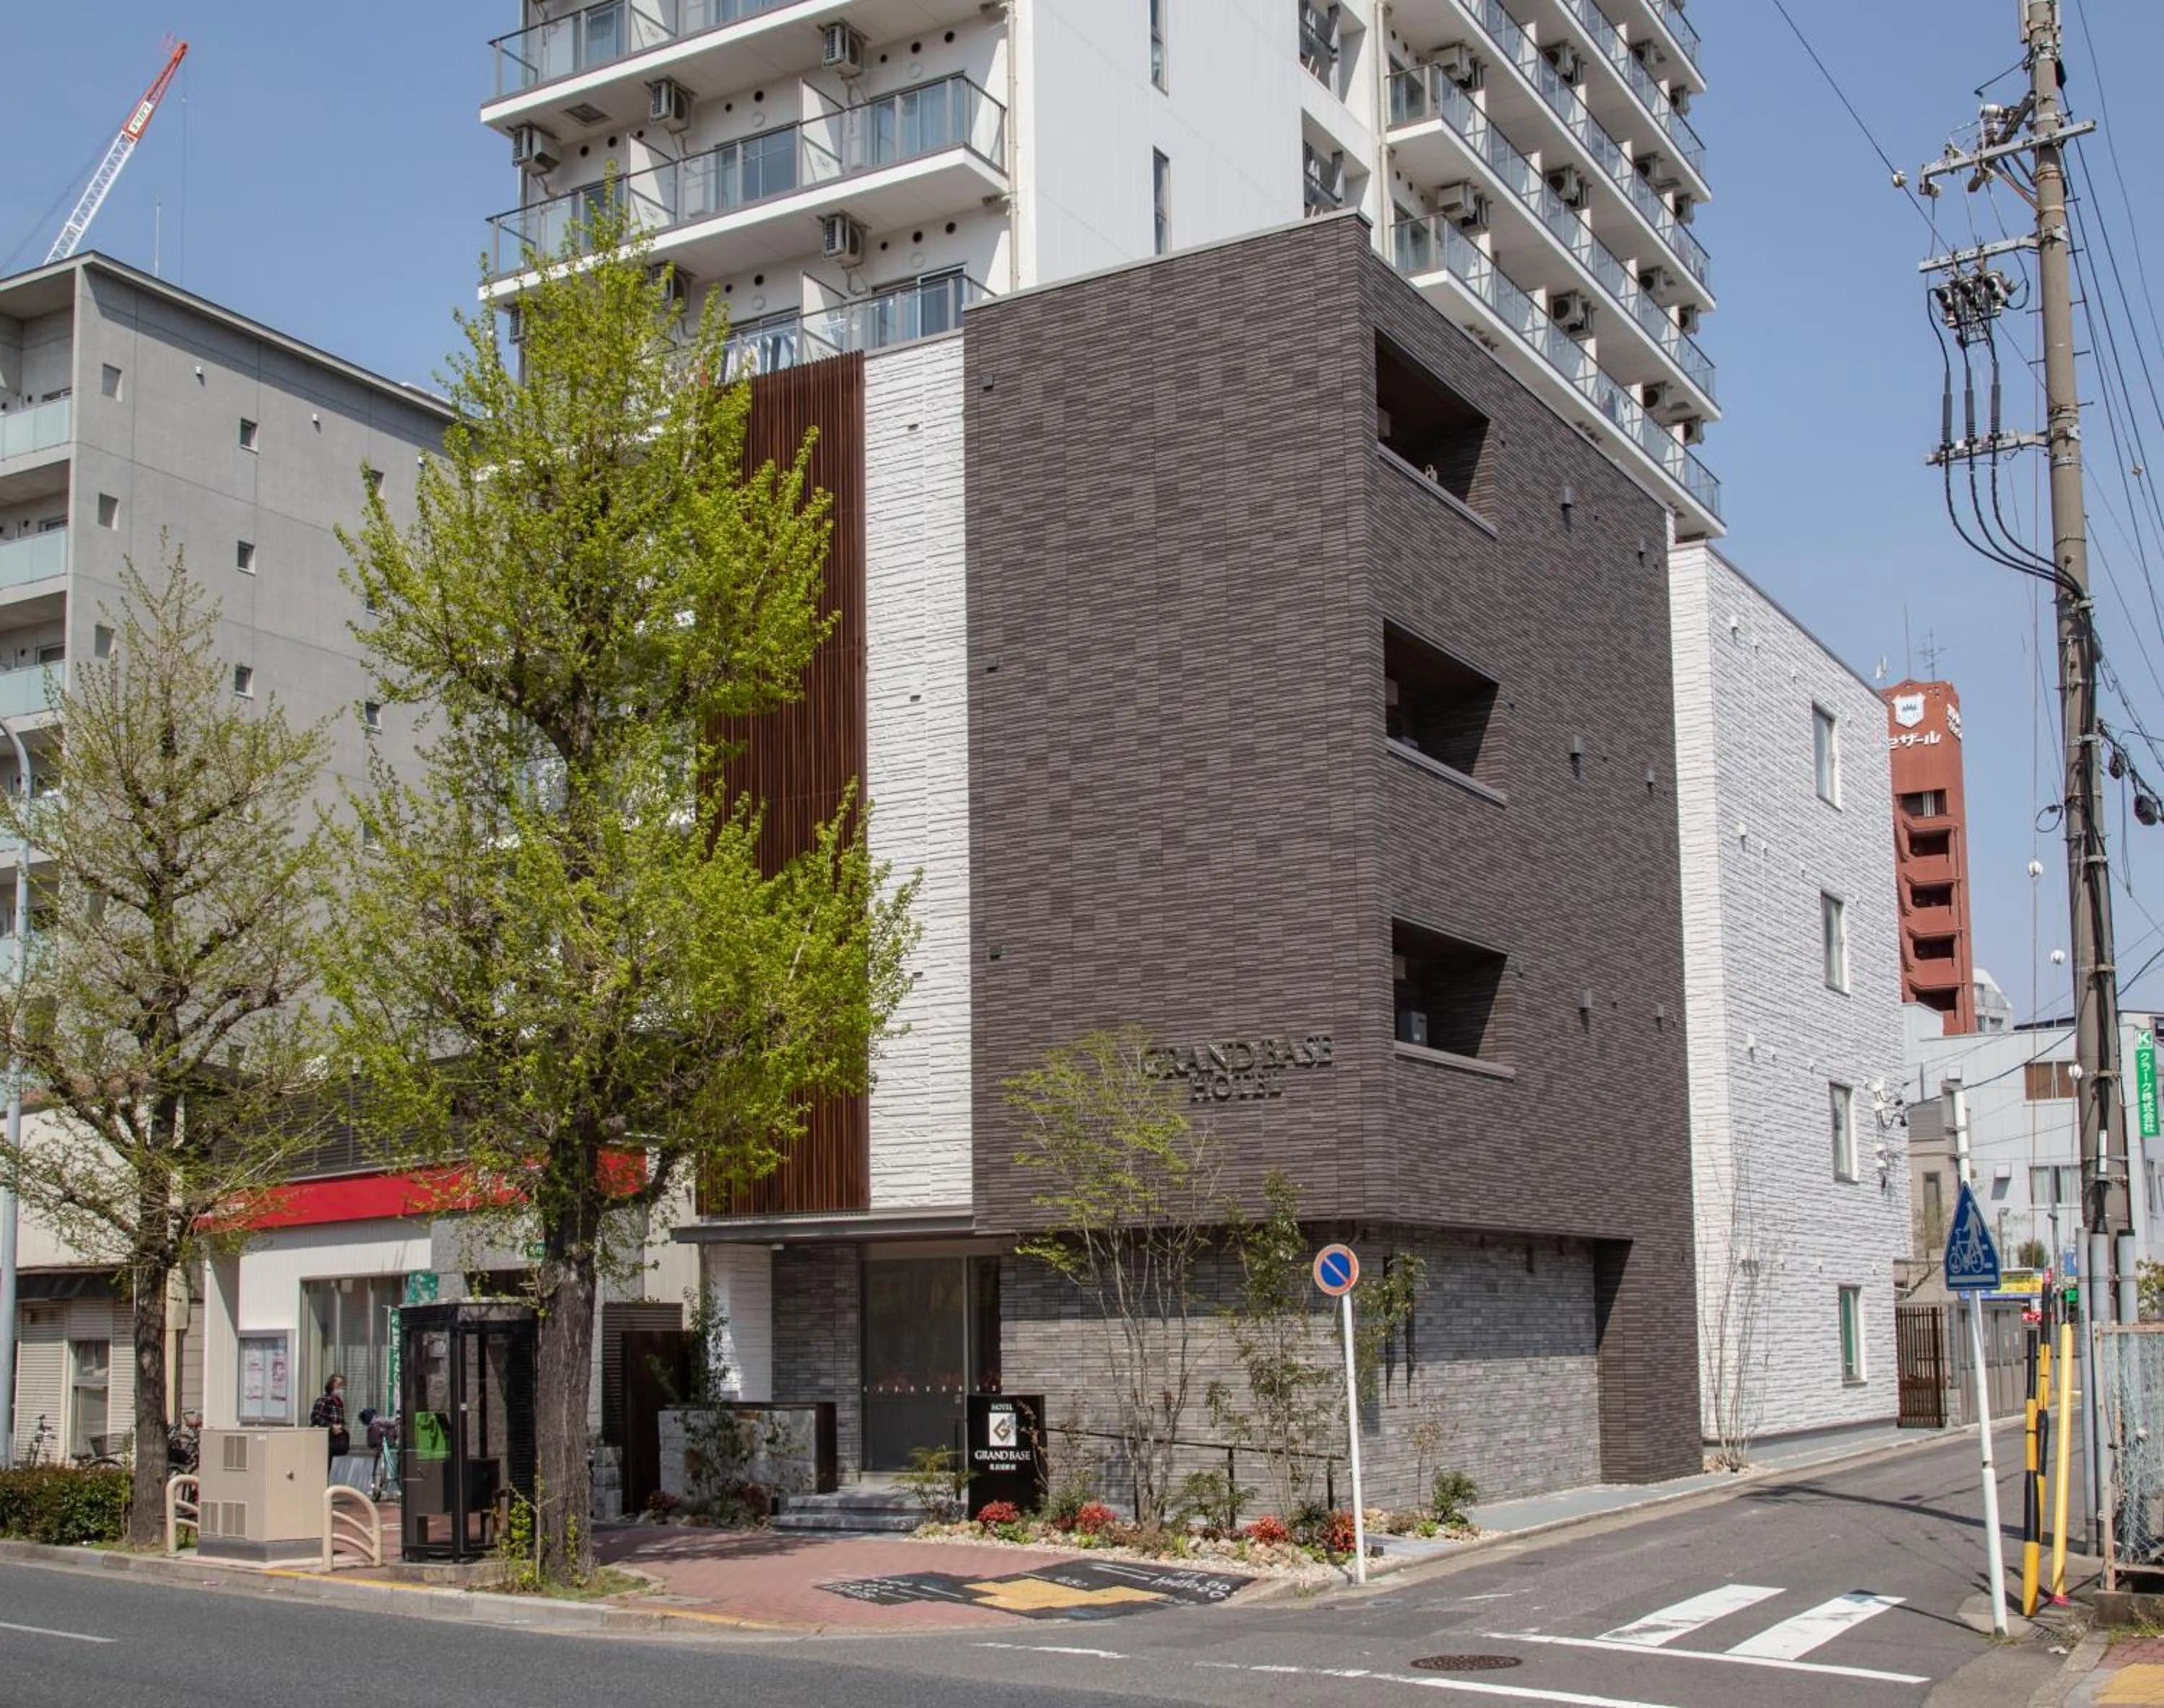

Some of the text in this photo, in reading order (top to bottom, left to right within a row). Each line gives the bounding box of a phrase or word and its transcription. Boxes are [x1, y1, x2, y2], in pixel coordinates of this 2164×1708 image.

[1262, 1036, 1334, 1069] BASE
[975, 1450, 1031, 1461] GRAND BASE
